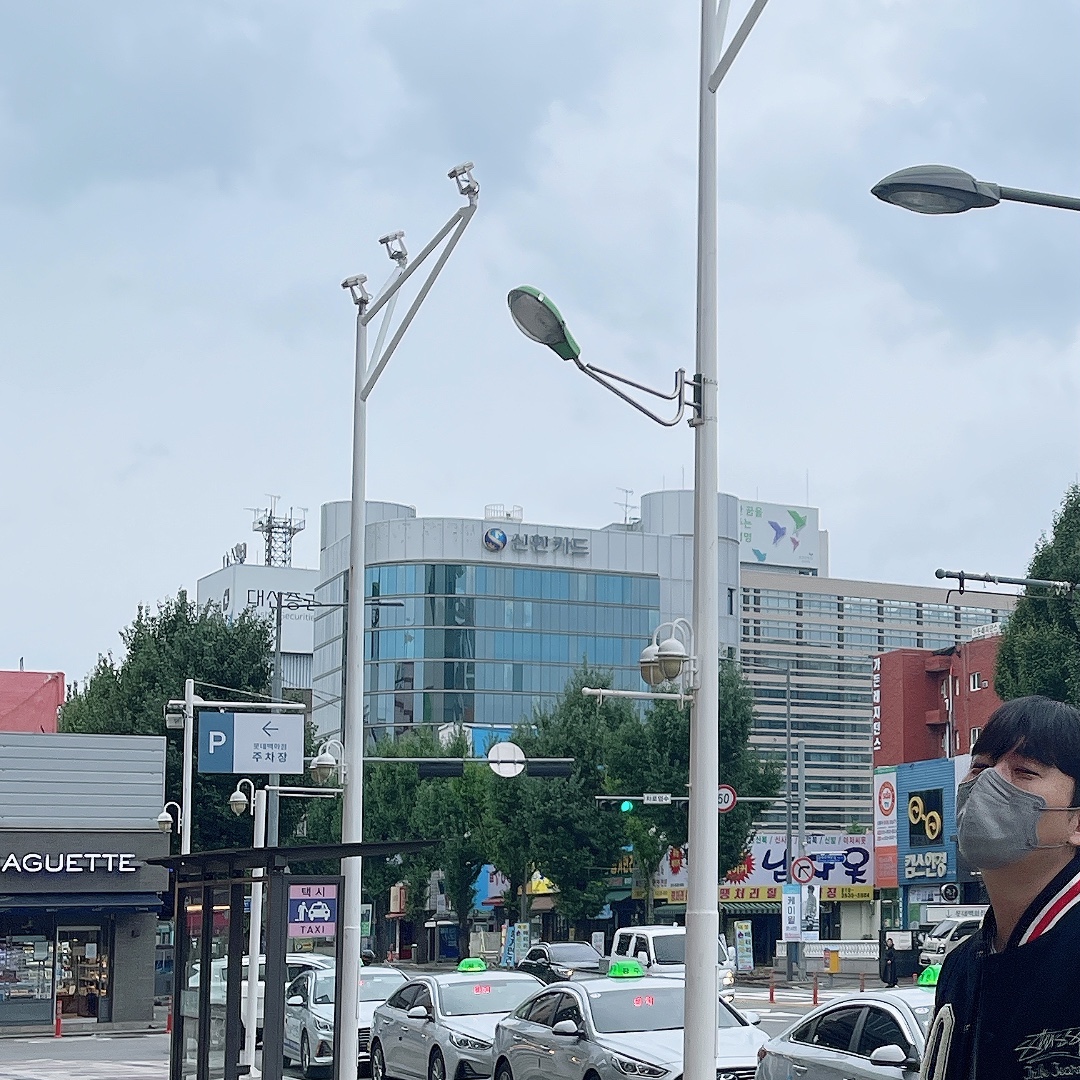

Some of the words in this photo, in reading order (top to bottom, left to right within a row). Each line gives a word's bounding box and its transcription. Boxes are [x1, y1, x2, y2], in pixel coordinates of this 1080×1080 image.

[511, 533, 589, 555] 신한카드
[209, 730, 226, 754] P
[252, 752, 287, 762] 주차장
[1, 853, 136, 872] AGUETTE
[301, 887, 325, 897] 택시
[301, 925, 325, 934] TAXI
